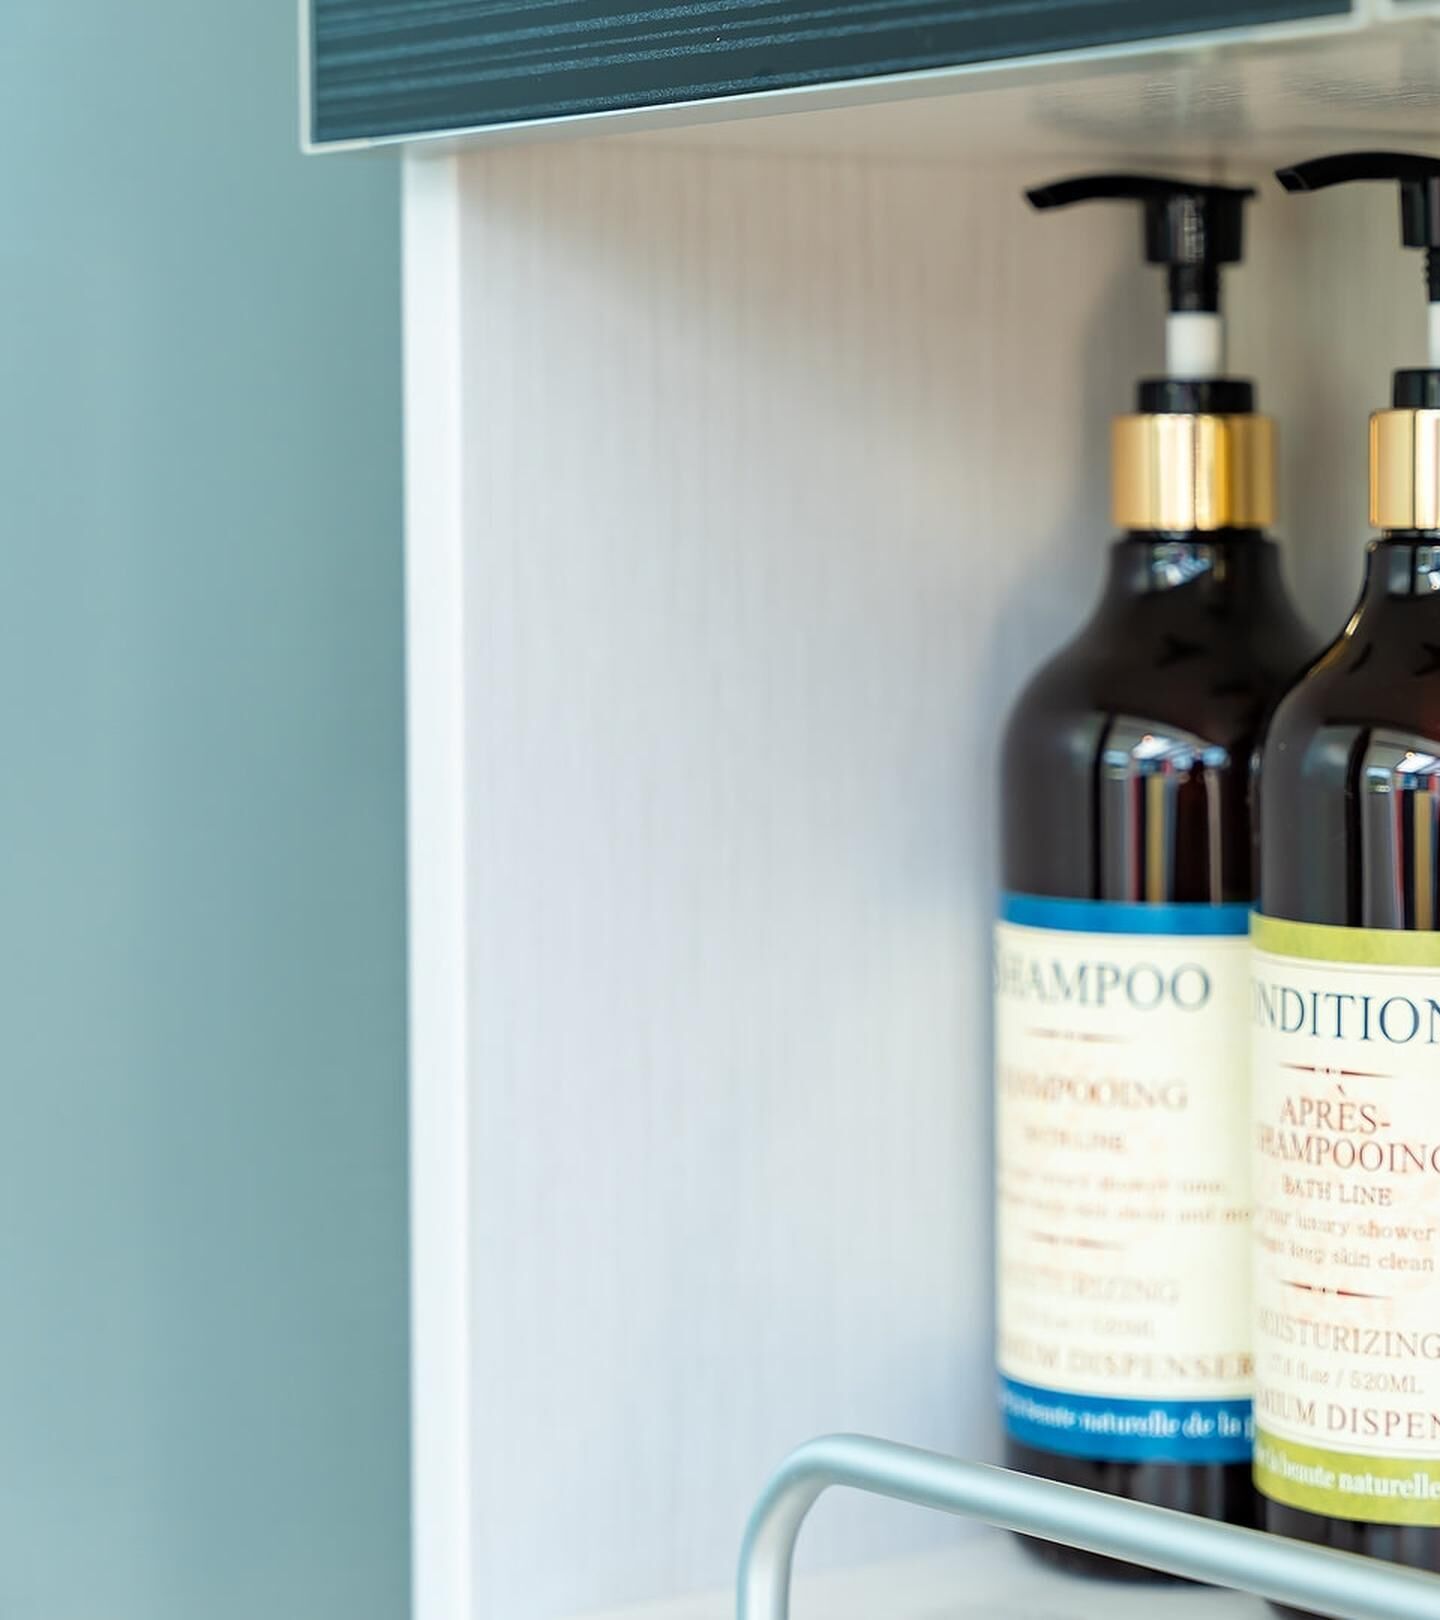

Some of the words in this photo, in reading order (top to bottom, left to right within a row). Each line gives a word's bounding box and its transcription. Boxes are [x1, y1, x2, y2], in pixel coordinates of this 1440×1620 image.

[993, 952, 1212, 1012] HAMPOO
[1280, 1084, 1391, 1135] APRÈS-
[1282, 1174, 1331, 1201] BATH
[1338, 1183, 1392, 1206] LINE
[1357, 1217, 1436, 1243] shower
[1332, 1246, 1371, 1269] skin
[1377, 1251, 1434, 1273] clean
